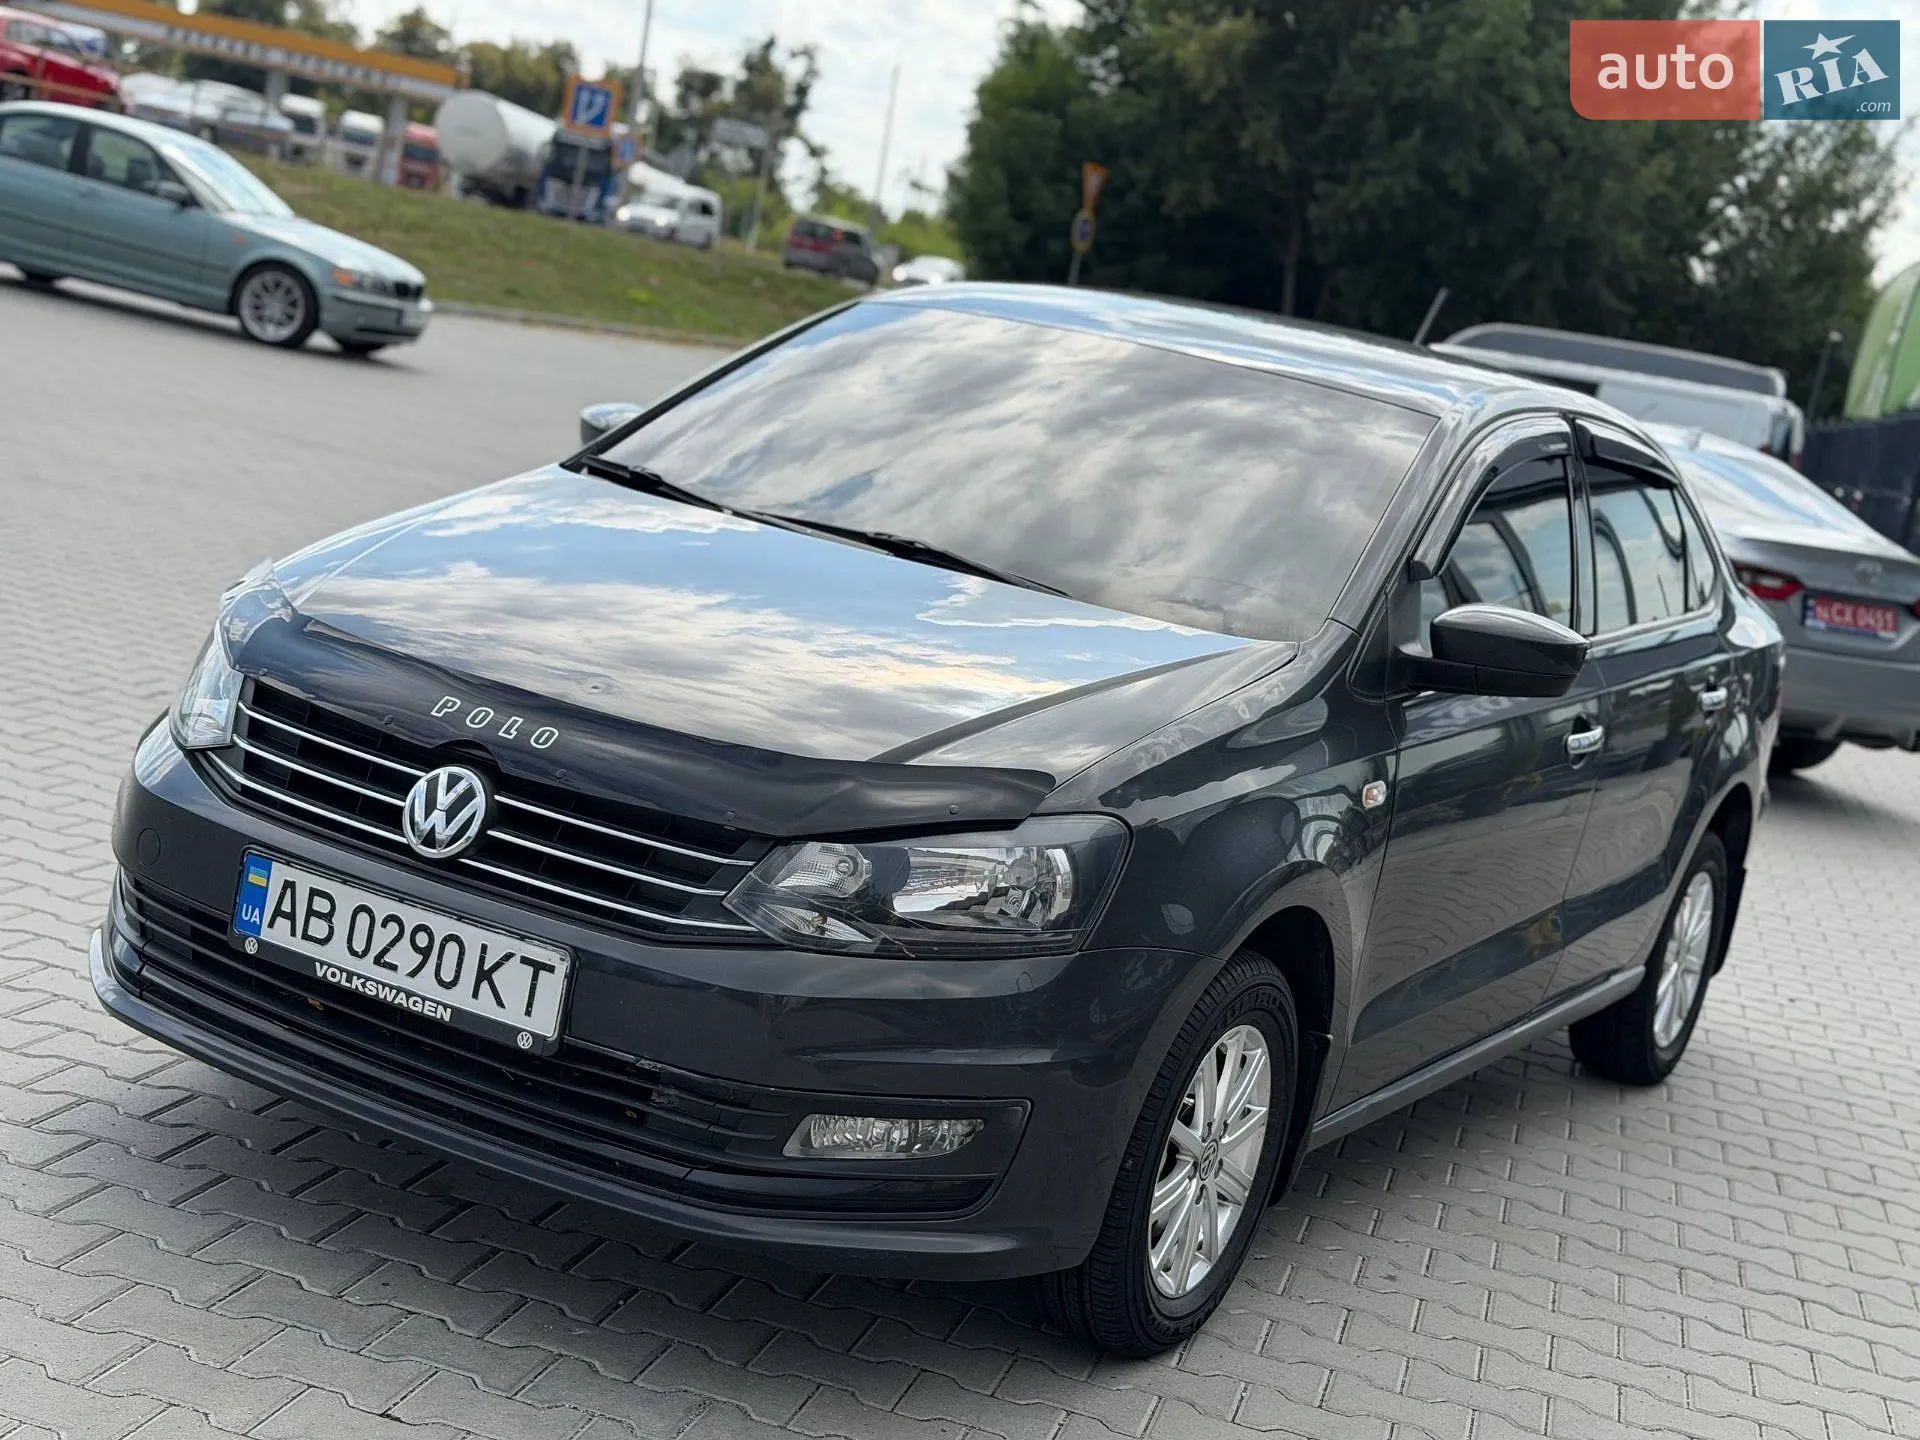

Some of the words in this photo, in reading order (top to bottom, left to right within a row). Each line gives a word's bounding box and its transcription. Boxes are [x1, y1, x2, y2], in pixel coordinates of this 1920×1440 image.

[431, 696, 559, 749] POLO
[242, 904, 261, 926] UA
[267, 880, 337, 946] AB
[346, 903, 466, 990] 0290
[471, 943, 555, 1018] KT
[314, 961, 452, 1022] VOLKSWAGEN
